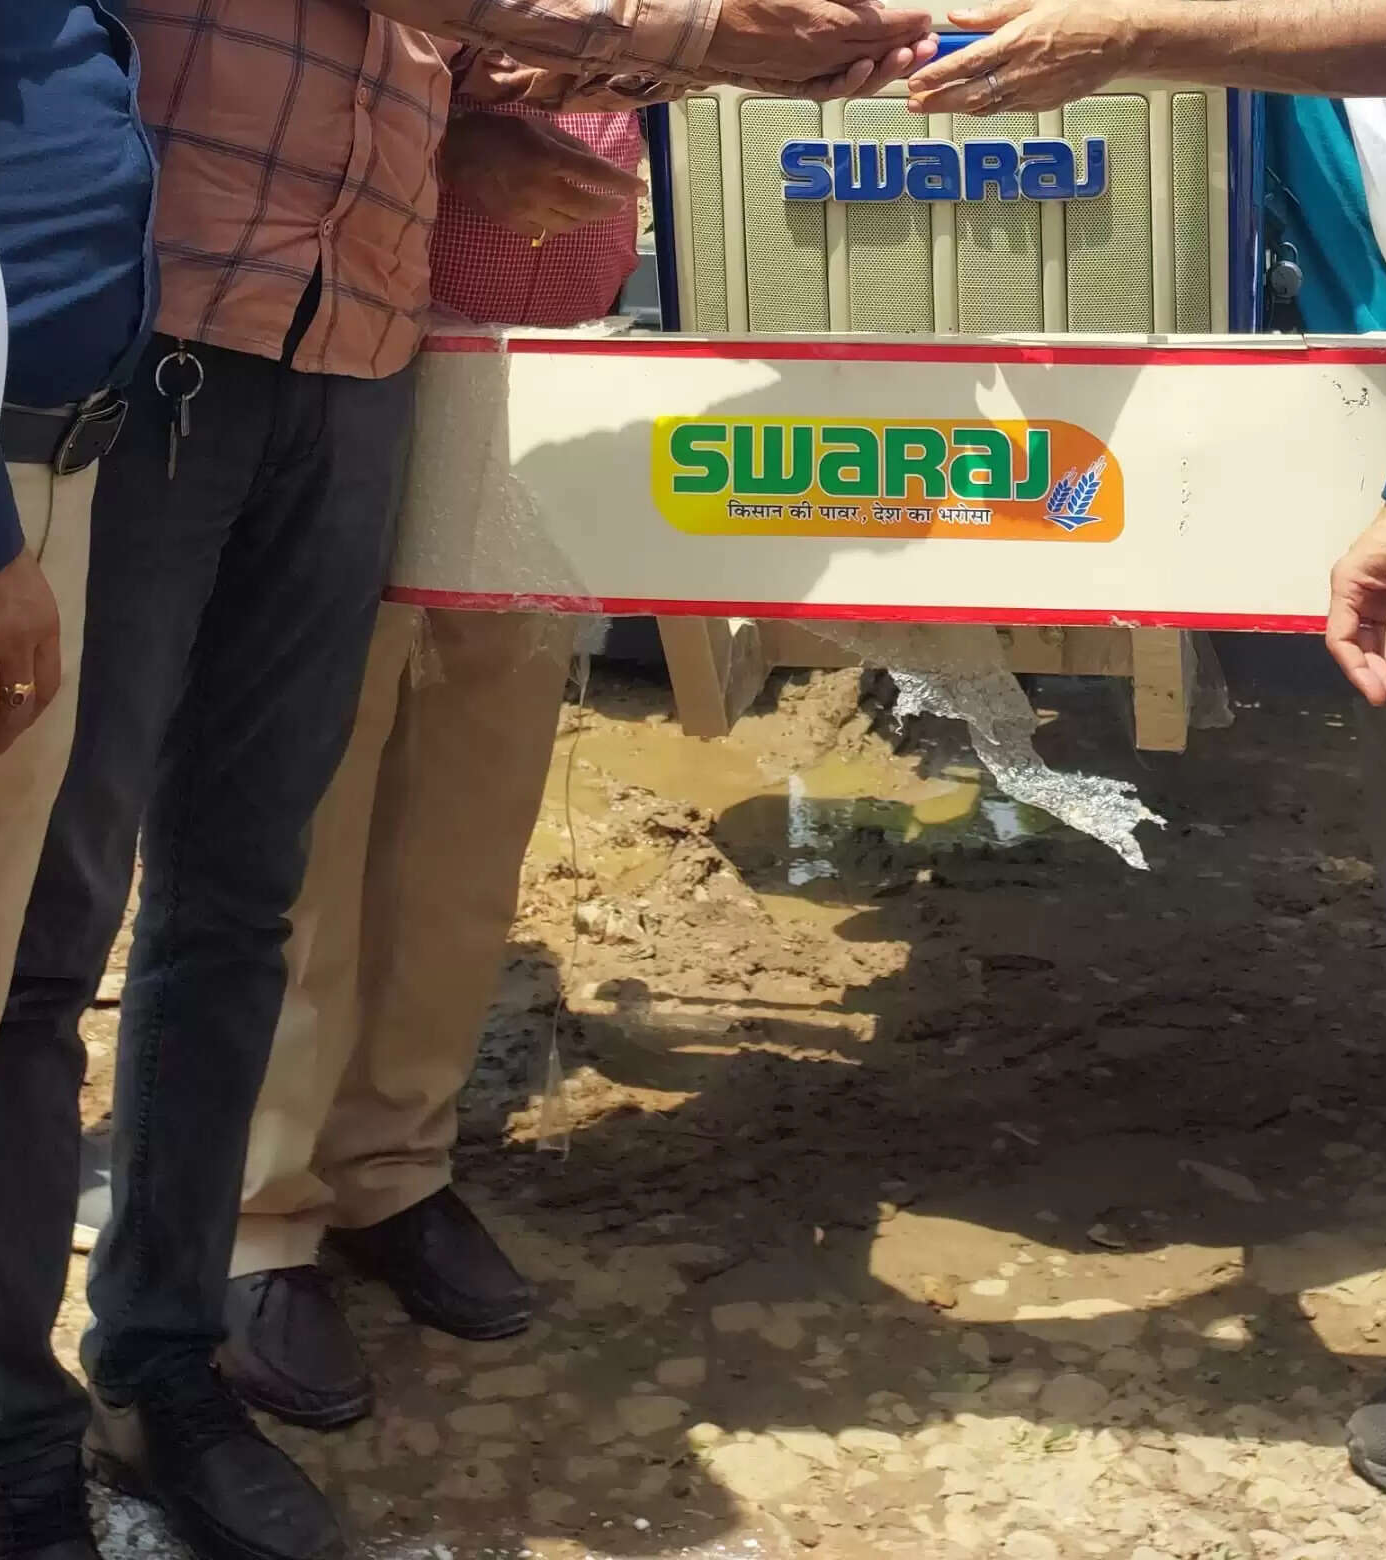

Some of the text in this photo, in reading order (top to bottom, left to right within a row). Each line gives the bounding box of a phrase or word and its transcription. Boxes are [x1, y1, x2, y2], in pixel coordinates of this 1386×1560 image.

[727, 500, 783, 520] किसान
[789, 500, 812, 520] की
[872, 503, 901, 523] देश
[906, 507, 932, 523] का
[938, 503, 992, 525] भरोसा
